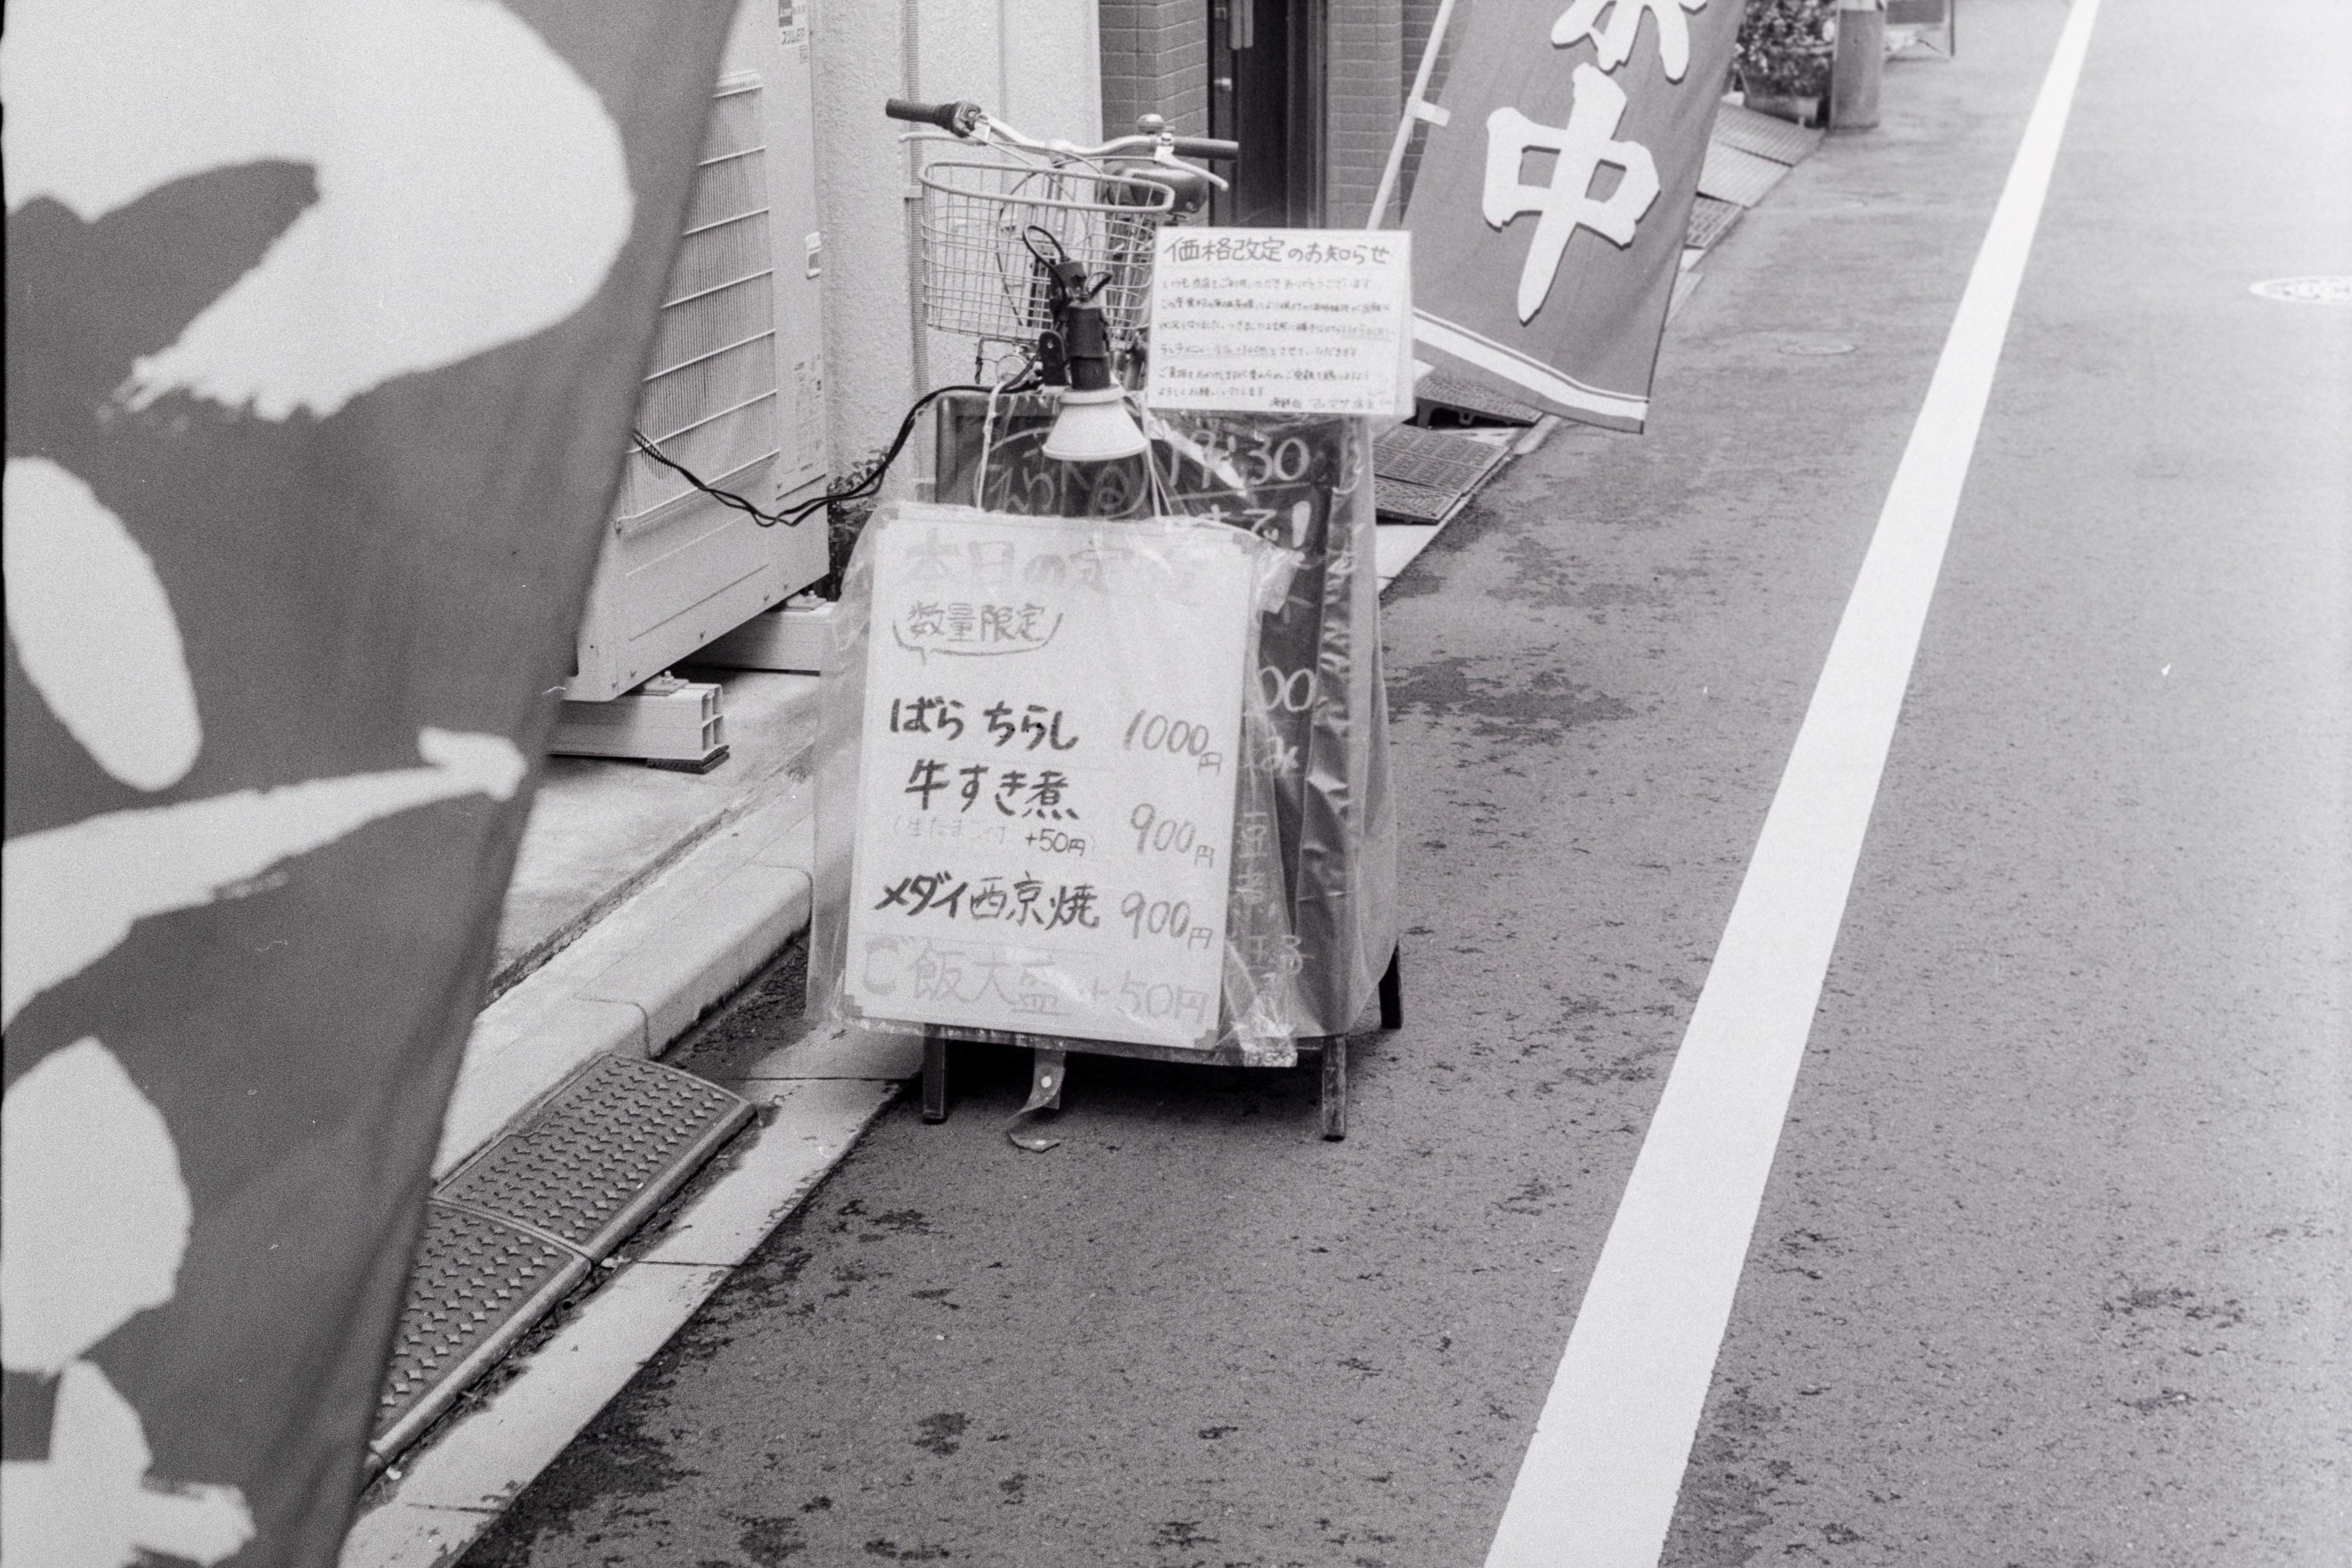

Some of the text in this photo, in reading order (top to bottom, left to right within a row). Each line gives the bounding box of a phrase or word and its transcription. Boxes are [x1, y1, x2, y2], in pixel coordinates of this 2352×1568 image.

[1163, 235, 1390, 266] 価格改定のお知らせ
[906, 602, 1047, 643] 数量限定
[1123, 709, 1222, 776] 1000円
[903, 758, 1215, 868] 牛すき煮 900円
[873, 870, 1214, 950] メダイ西京焼 900円
